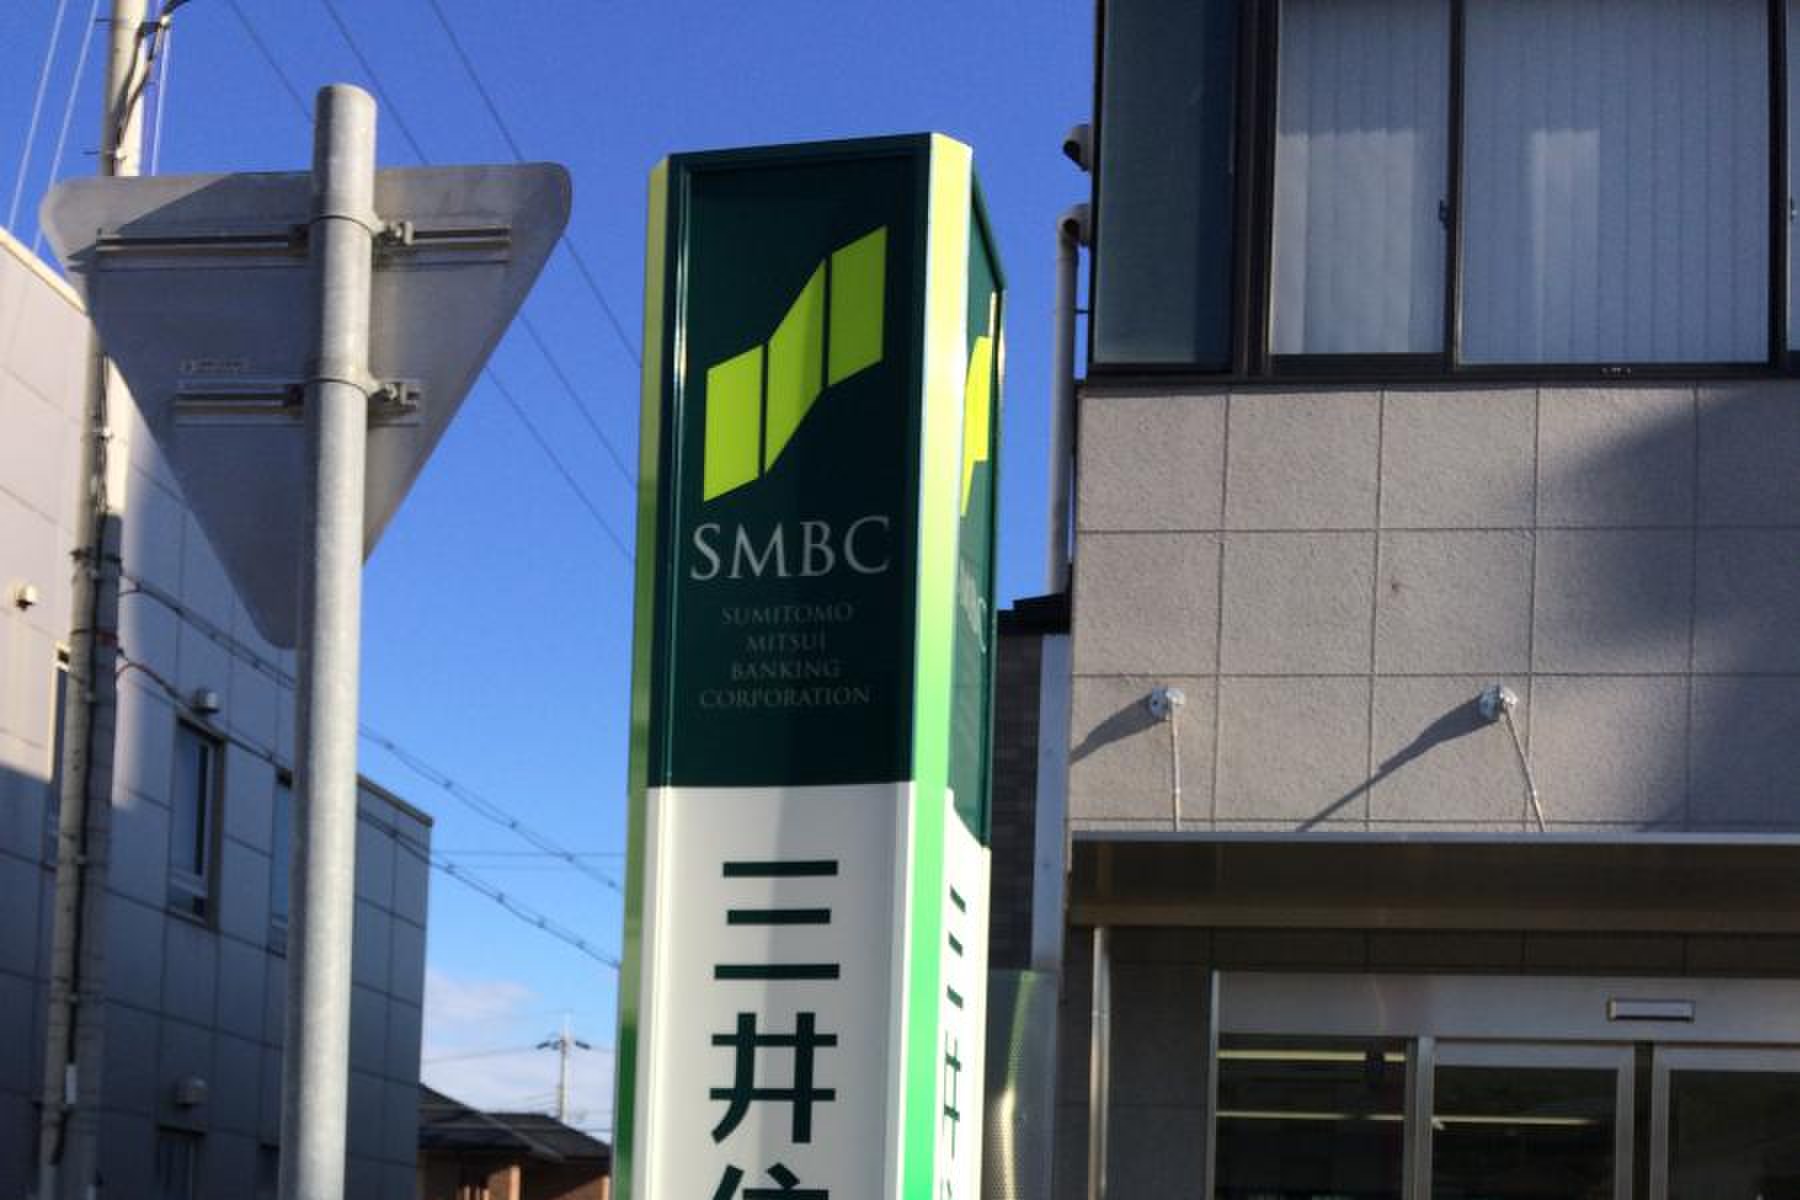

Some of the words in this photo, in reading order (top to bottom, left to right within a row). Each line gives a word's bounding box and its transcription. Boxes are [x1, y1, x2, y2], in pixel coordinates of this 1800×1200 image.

[690, 514, 891, 581] SMBC
[720, 602, 854, 625] SUMITOMO
[745, 631, 827, 653] MITSUI
[730, 658, 841, 682] BANKING
[699, 685, 871, 710] CORPORATION
